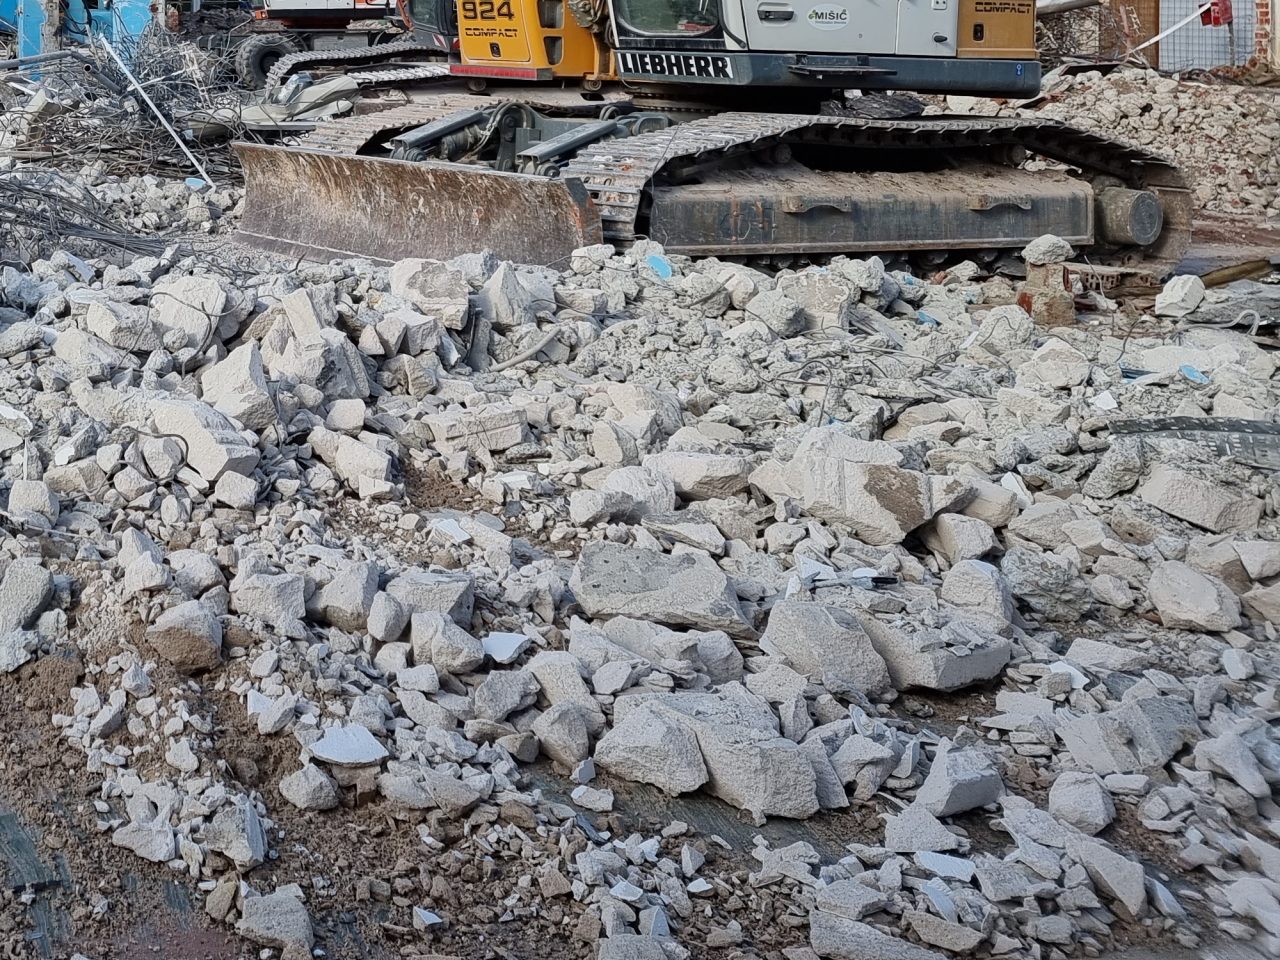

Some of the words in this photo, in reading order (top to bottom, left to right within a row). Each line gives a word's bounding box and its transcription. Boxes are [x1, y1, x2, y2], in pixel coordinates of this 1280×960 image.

[462, 0, 515, 21] 924
[974, 2, 1031, 14] COMPACT
[465, 28, 518, 37] COMPACT
[620, 53, 731, 78] LIEBHERR
